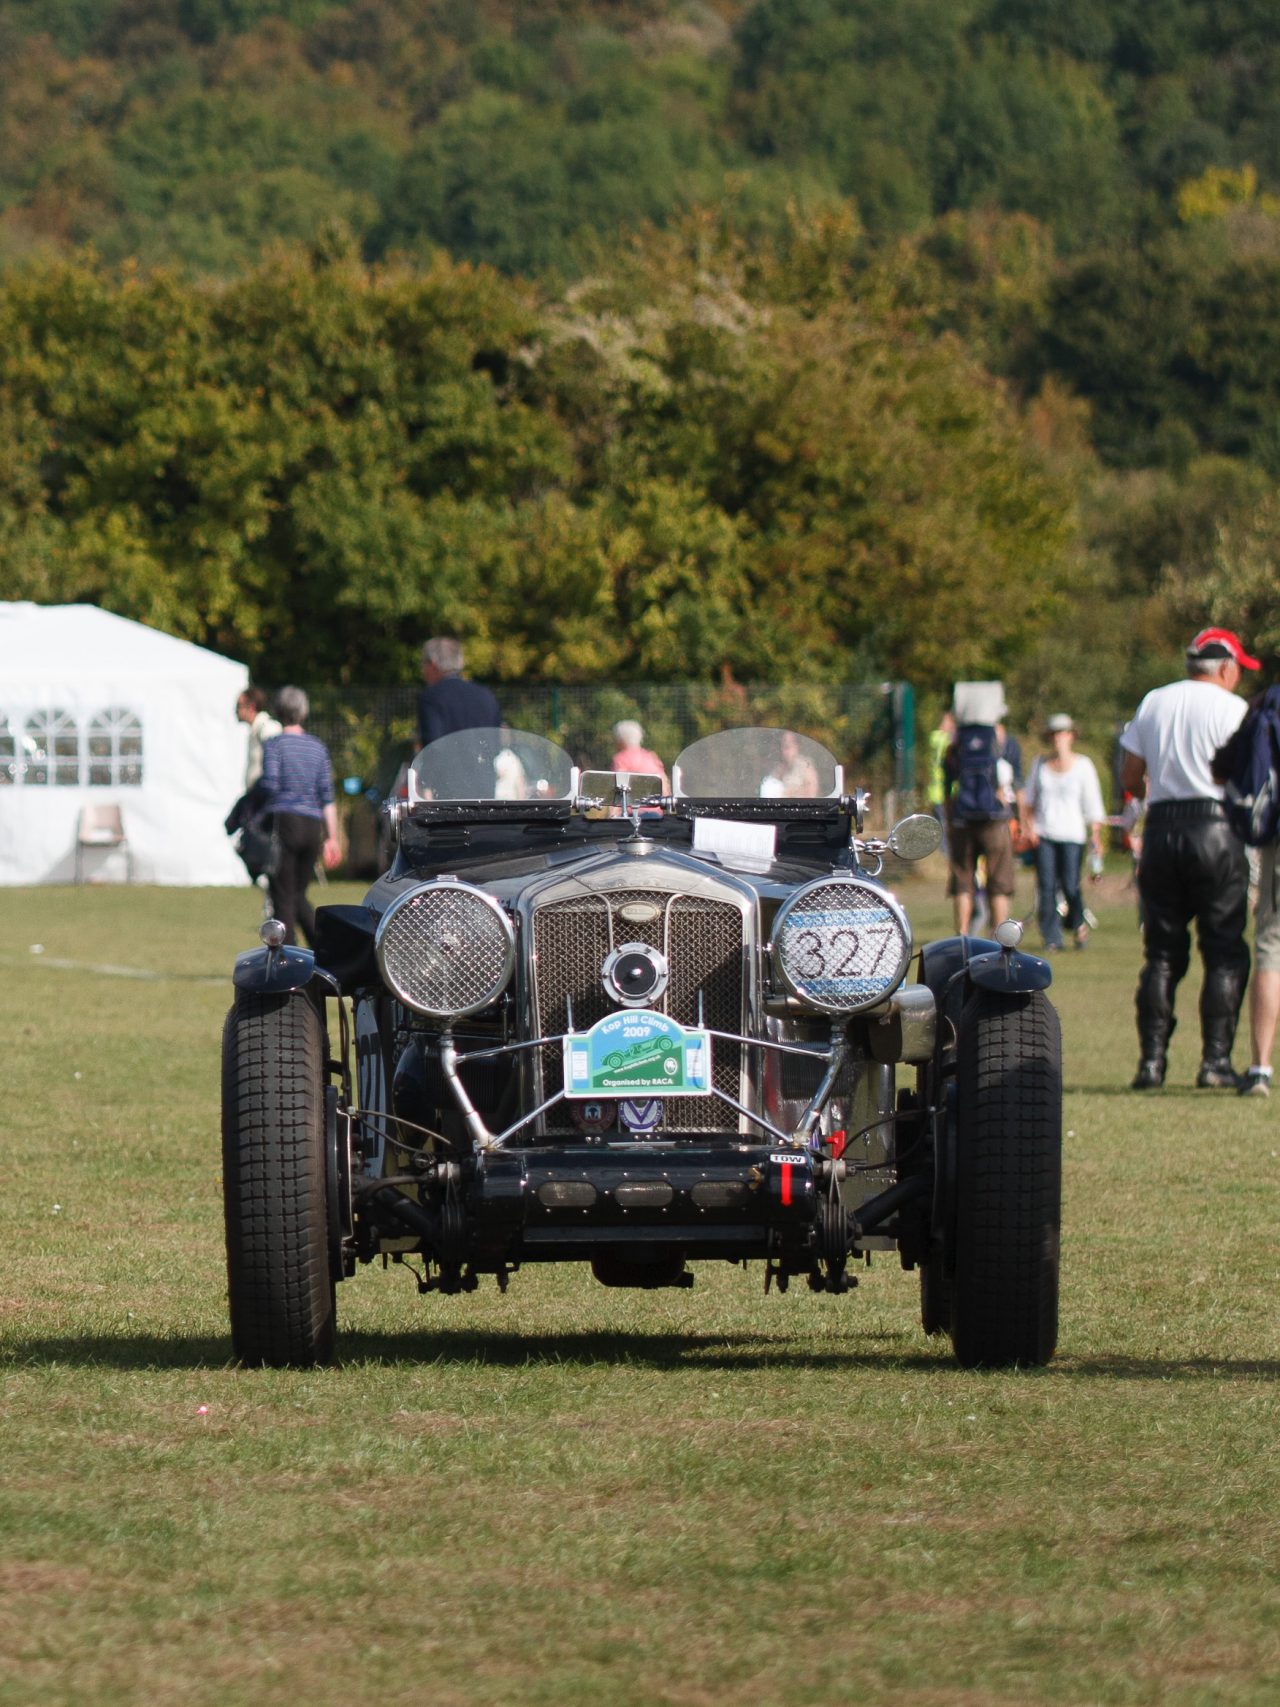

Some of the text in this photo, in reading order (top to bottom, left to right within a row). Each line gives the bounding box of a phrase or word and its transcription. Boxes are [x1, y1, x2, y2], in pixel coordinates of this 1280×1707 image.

[794, 927, 893, 979] 327
[601, 1015, 669, 1034] Kop Hill Climb
[623, 1027, 651, 1037] 2009
[602, 1079, 640, 1087] Organised
